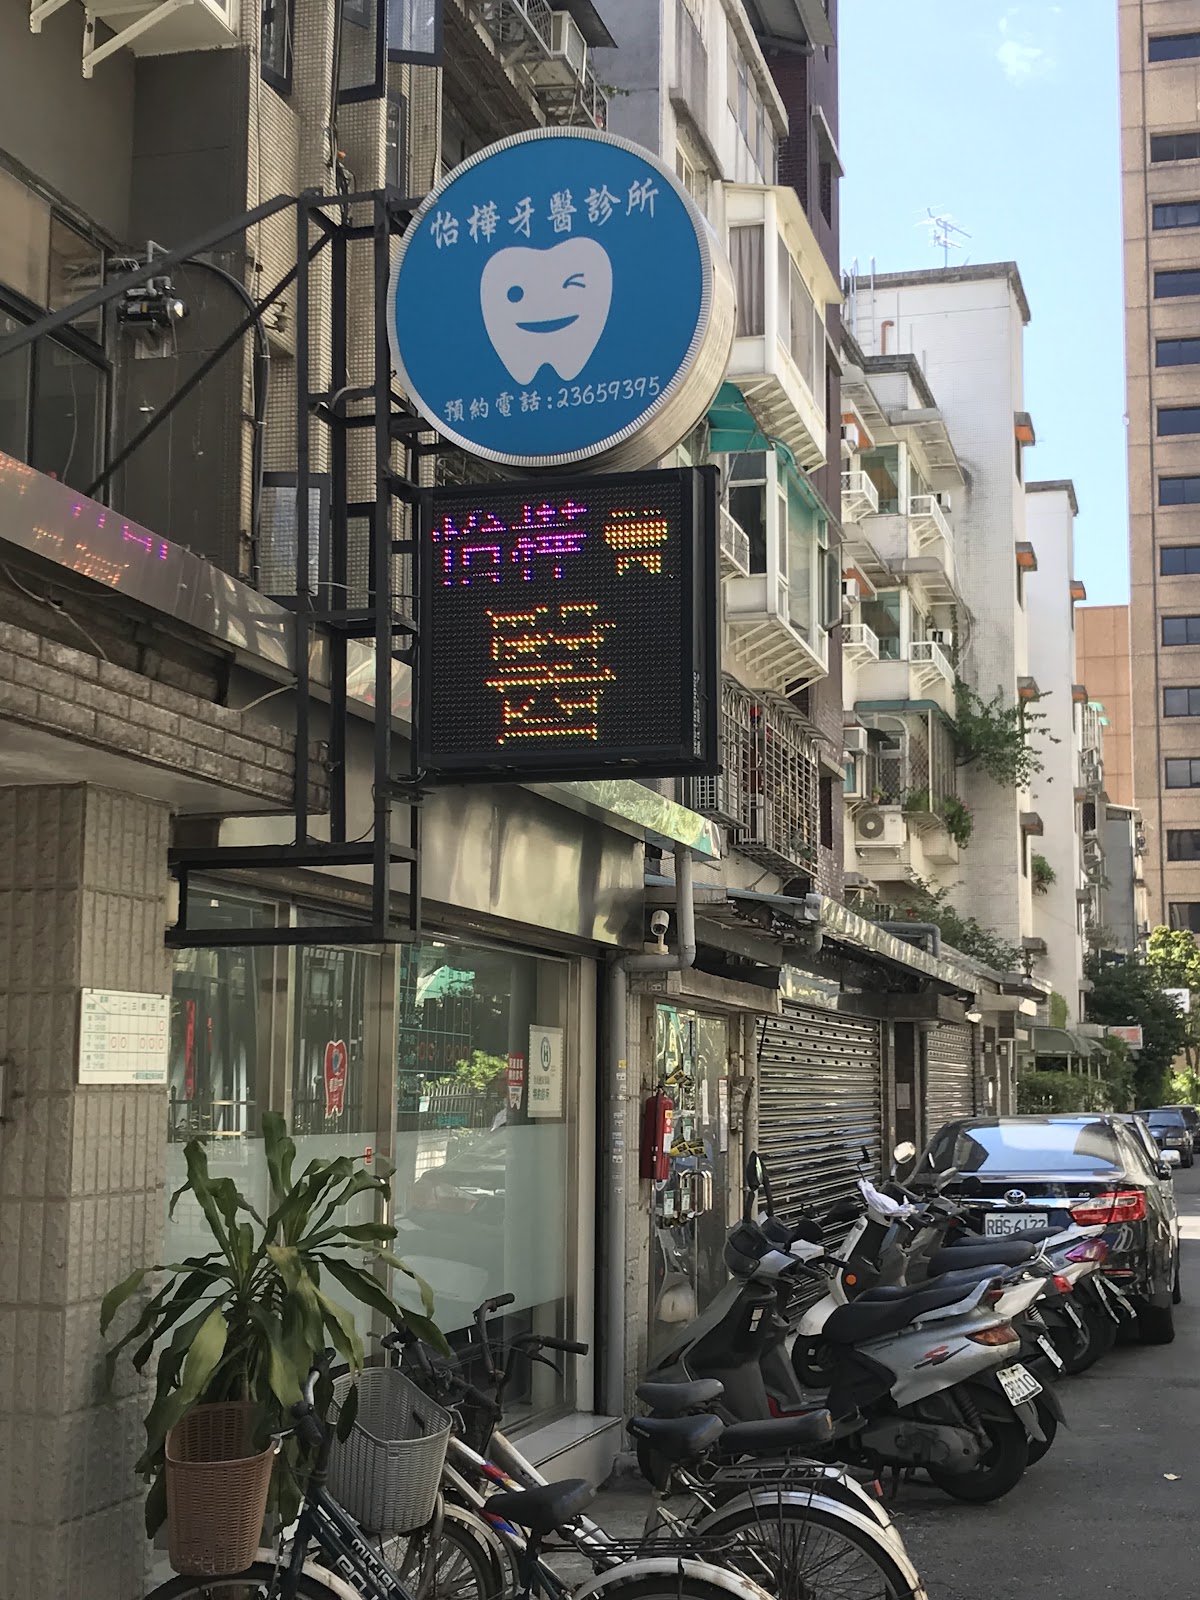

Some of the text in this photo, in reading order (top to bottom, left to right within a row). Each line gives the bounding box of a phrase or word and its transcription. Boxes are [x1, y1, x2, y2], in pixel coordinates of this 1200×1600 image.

[429, 177, 660, 250] 怡樺牙醫診所
